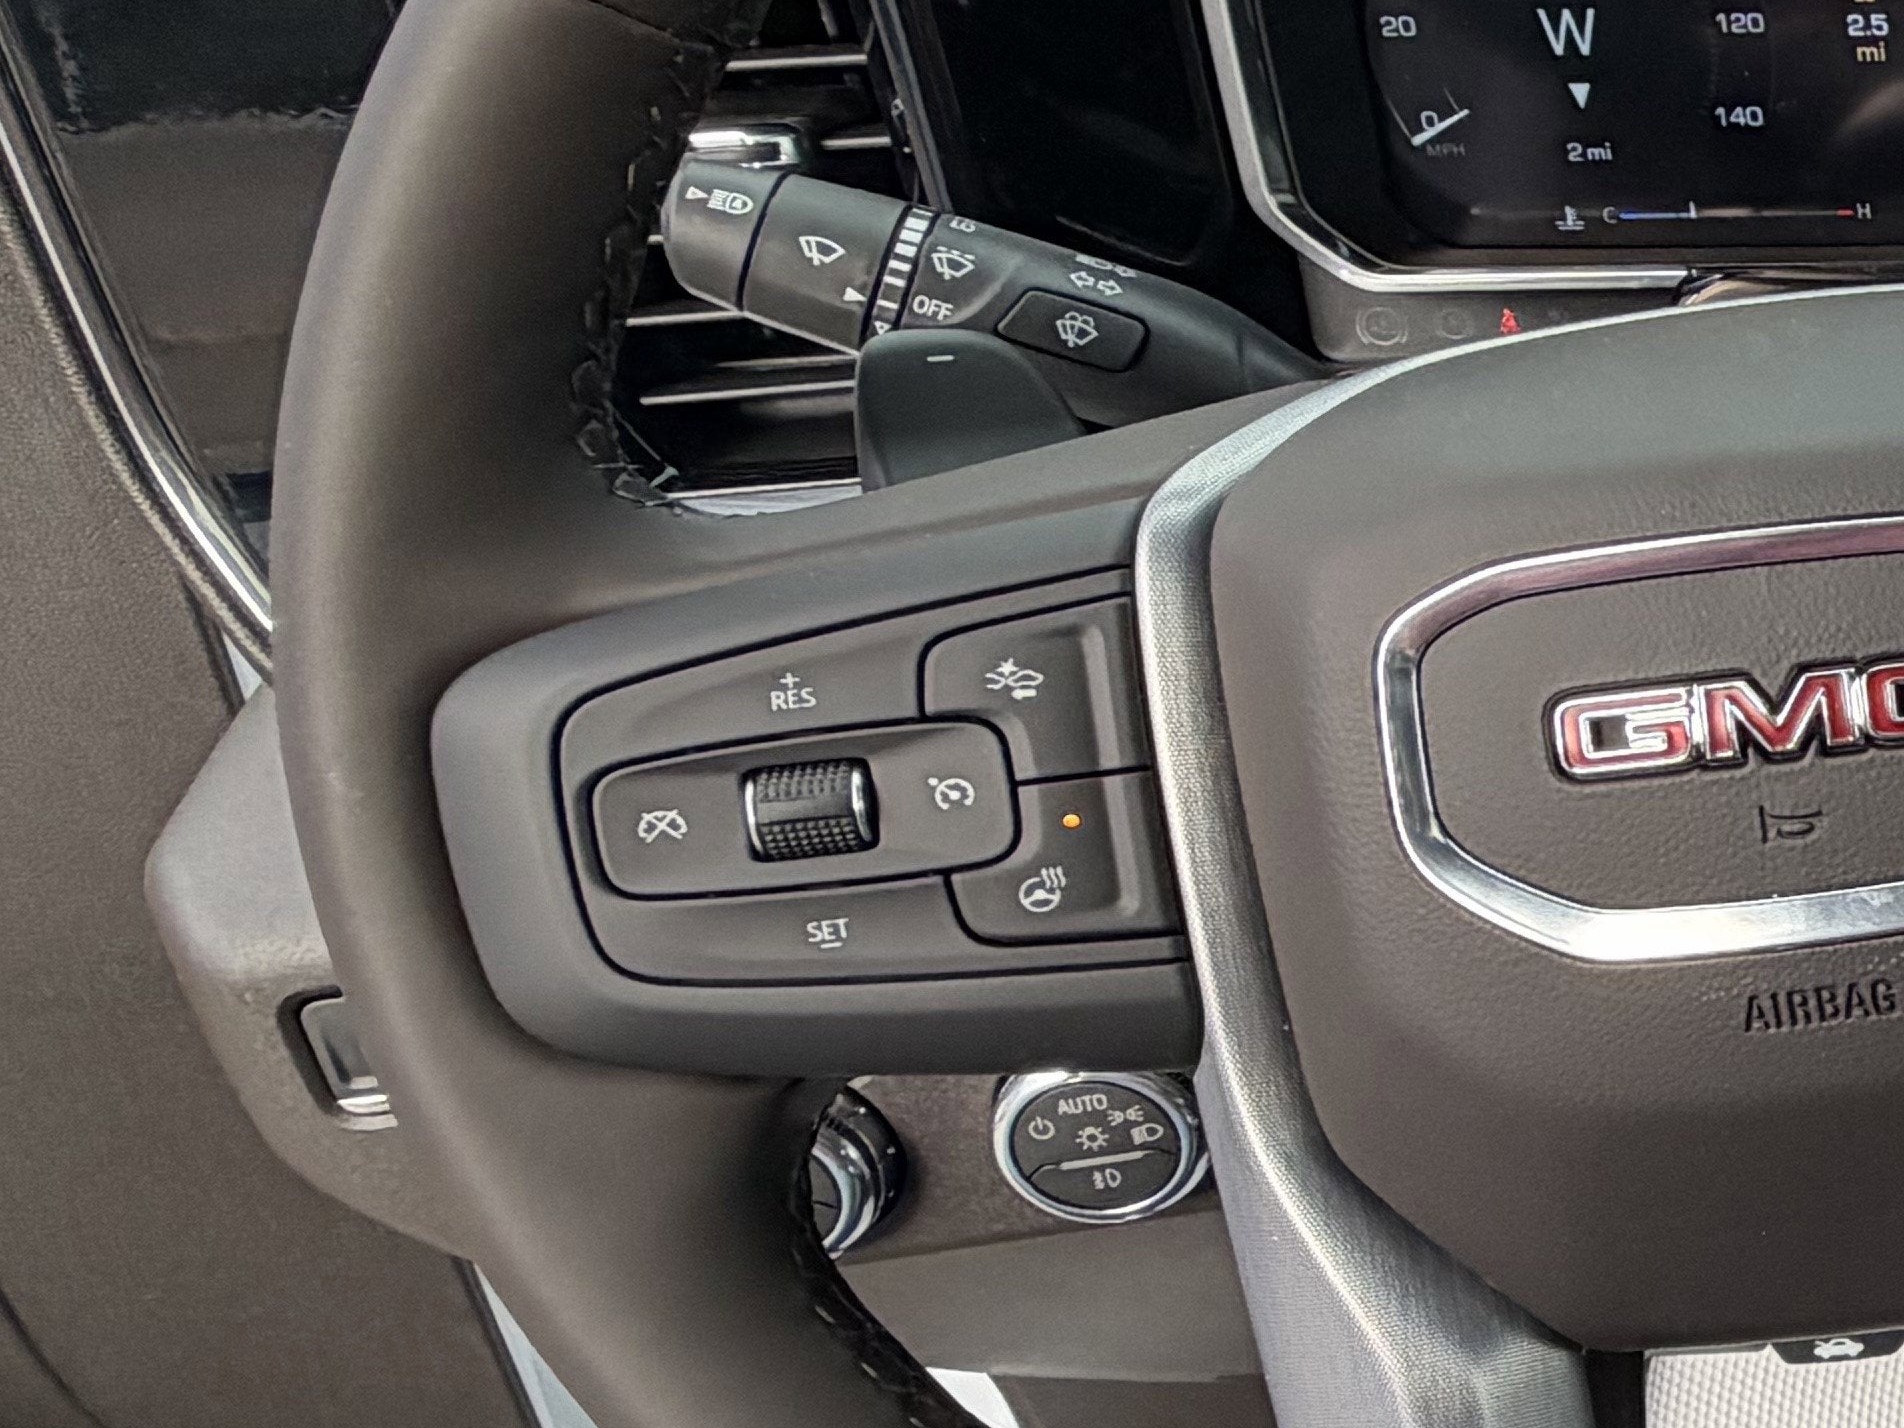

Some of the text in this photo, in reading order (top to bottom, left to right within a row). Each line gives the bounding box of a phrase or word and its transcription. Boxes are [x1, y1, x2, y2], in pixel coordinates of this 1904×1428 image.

[1379, 15, 1417, 38] 20
[1536, 6, 1596, 57] W
[1715, 12, 1765, 35] 120
[1846, 13, 1889, 37] 2.5
[1856, 41, 1887, 64] mi
[1713, 105, 1765, 128] 140
[1566, 142, 1613, 163] 2 mi
[912, 294, 955, 321] OFF
[769, 686, 817, 712] RES
[806, 917, 849, 943] SET
[1743, 978, 1898, 1034] AIRBAG
[1057, 1093, 1108, 1116] AUTO
